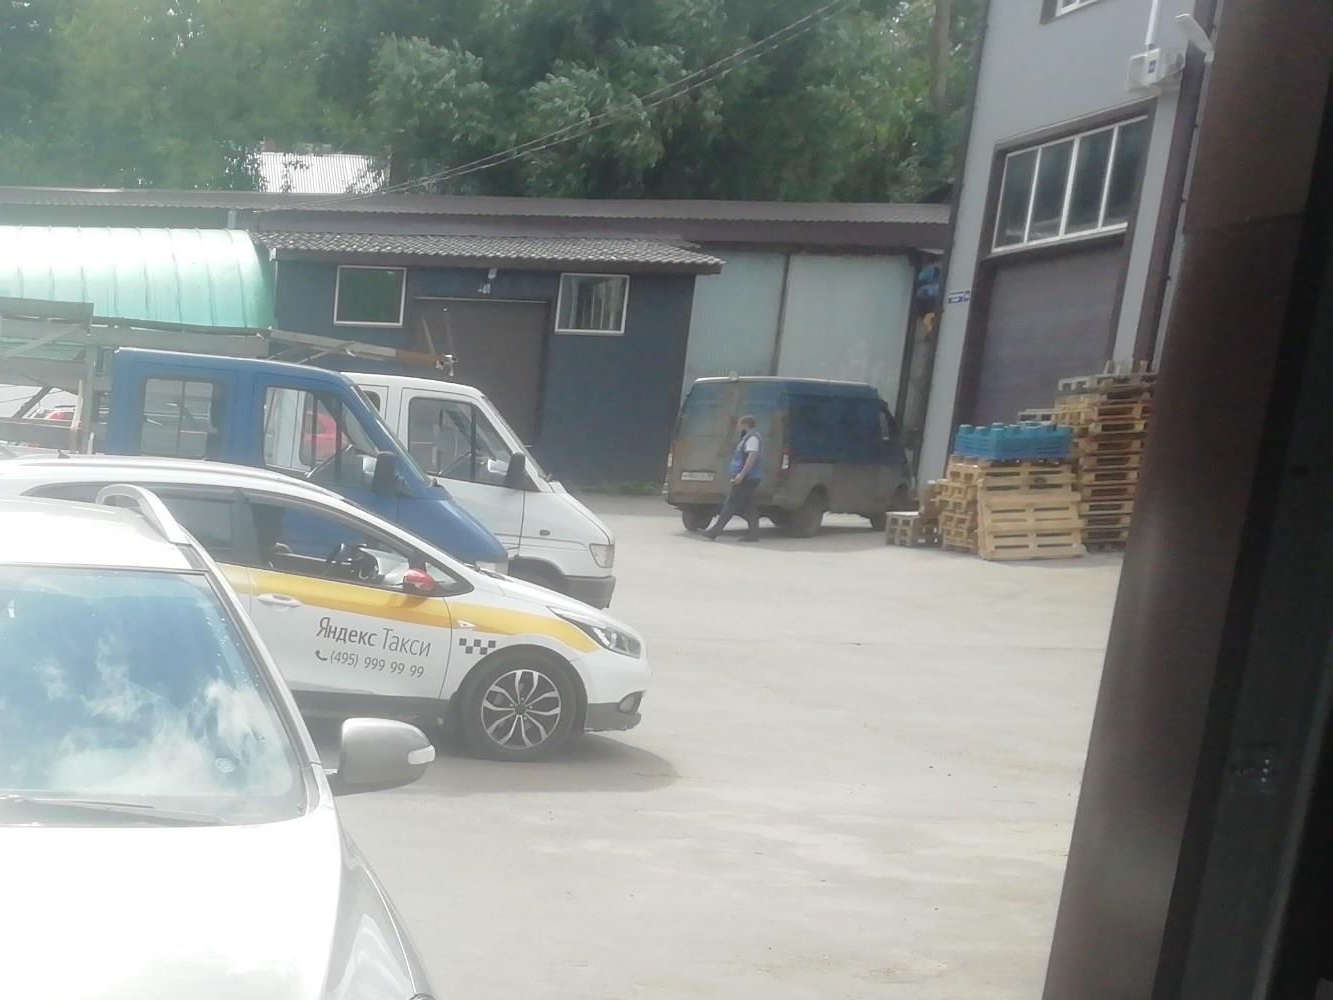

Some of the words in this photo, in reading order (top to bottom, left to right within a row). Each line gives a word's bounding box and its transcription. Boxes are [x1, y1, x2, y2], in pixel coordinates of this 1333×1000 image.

[316, 616, 378, 647] Яндекс
[382, 627, 432, 657] Такси
[329, 649, 359, 668] (495)
[364, 656, 386, 672] 999
[390, 660, 405, 675] 99
[410, 664, 425, 678] 99
